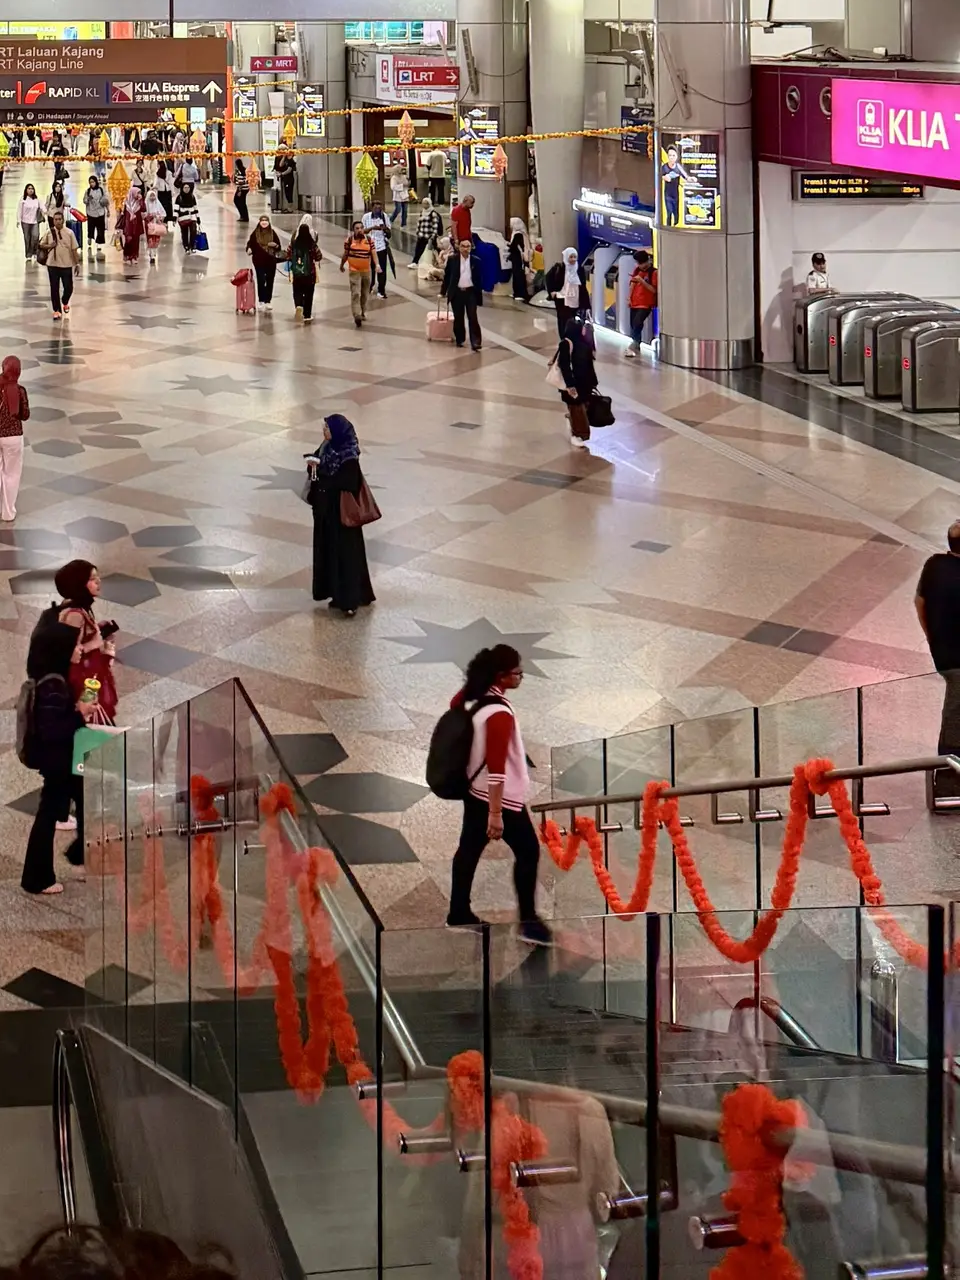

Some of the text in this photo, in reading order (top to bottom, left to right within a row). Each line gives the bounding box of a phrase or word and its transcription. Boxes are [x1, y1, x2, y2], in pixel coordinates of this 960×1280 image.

[17, 47, 59, 57] Laluan
[62, 46, 104, 58] Kajang
[17, 59, 57, 72] Kajang
[60, 59, 84, 69] Line
[275, 59, 293, 67] MRT
[413, 71, 435, 81] LRT
[48, 87, 82, 98] RAPID
[85, 87, 100, 97] KL
[134, 81, 200, 94] KLIA Ekspres
[45, 113, 72, 121] Hadapan
[889, 108, 950, 150] KLIA
